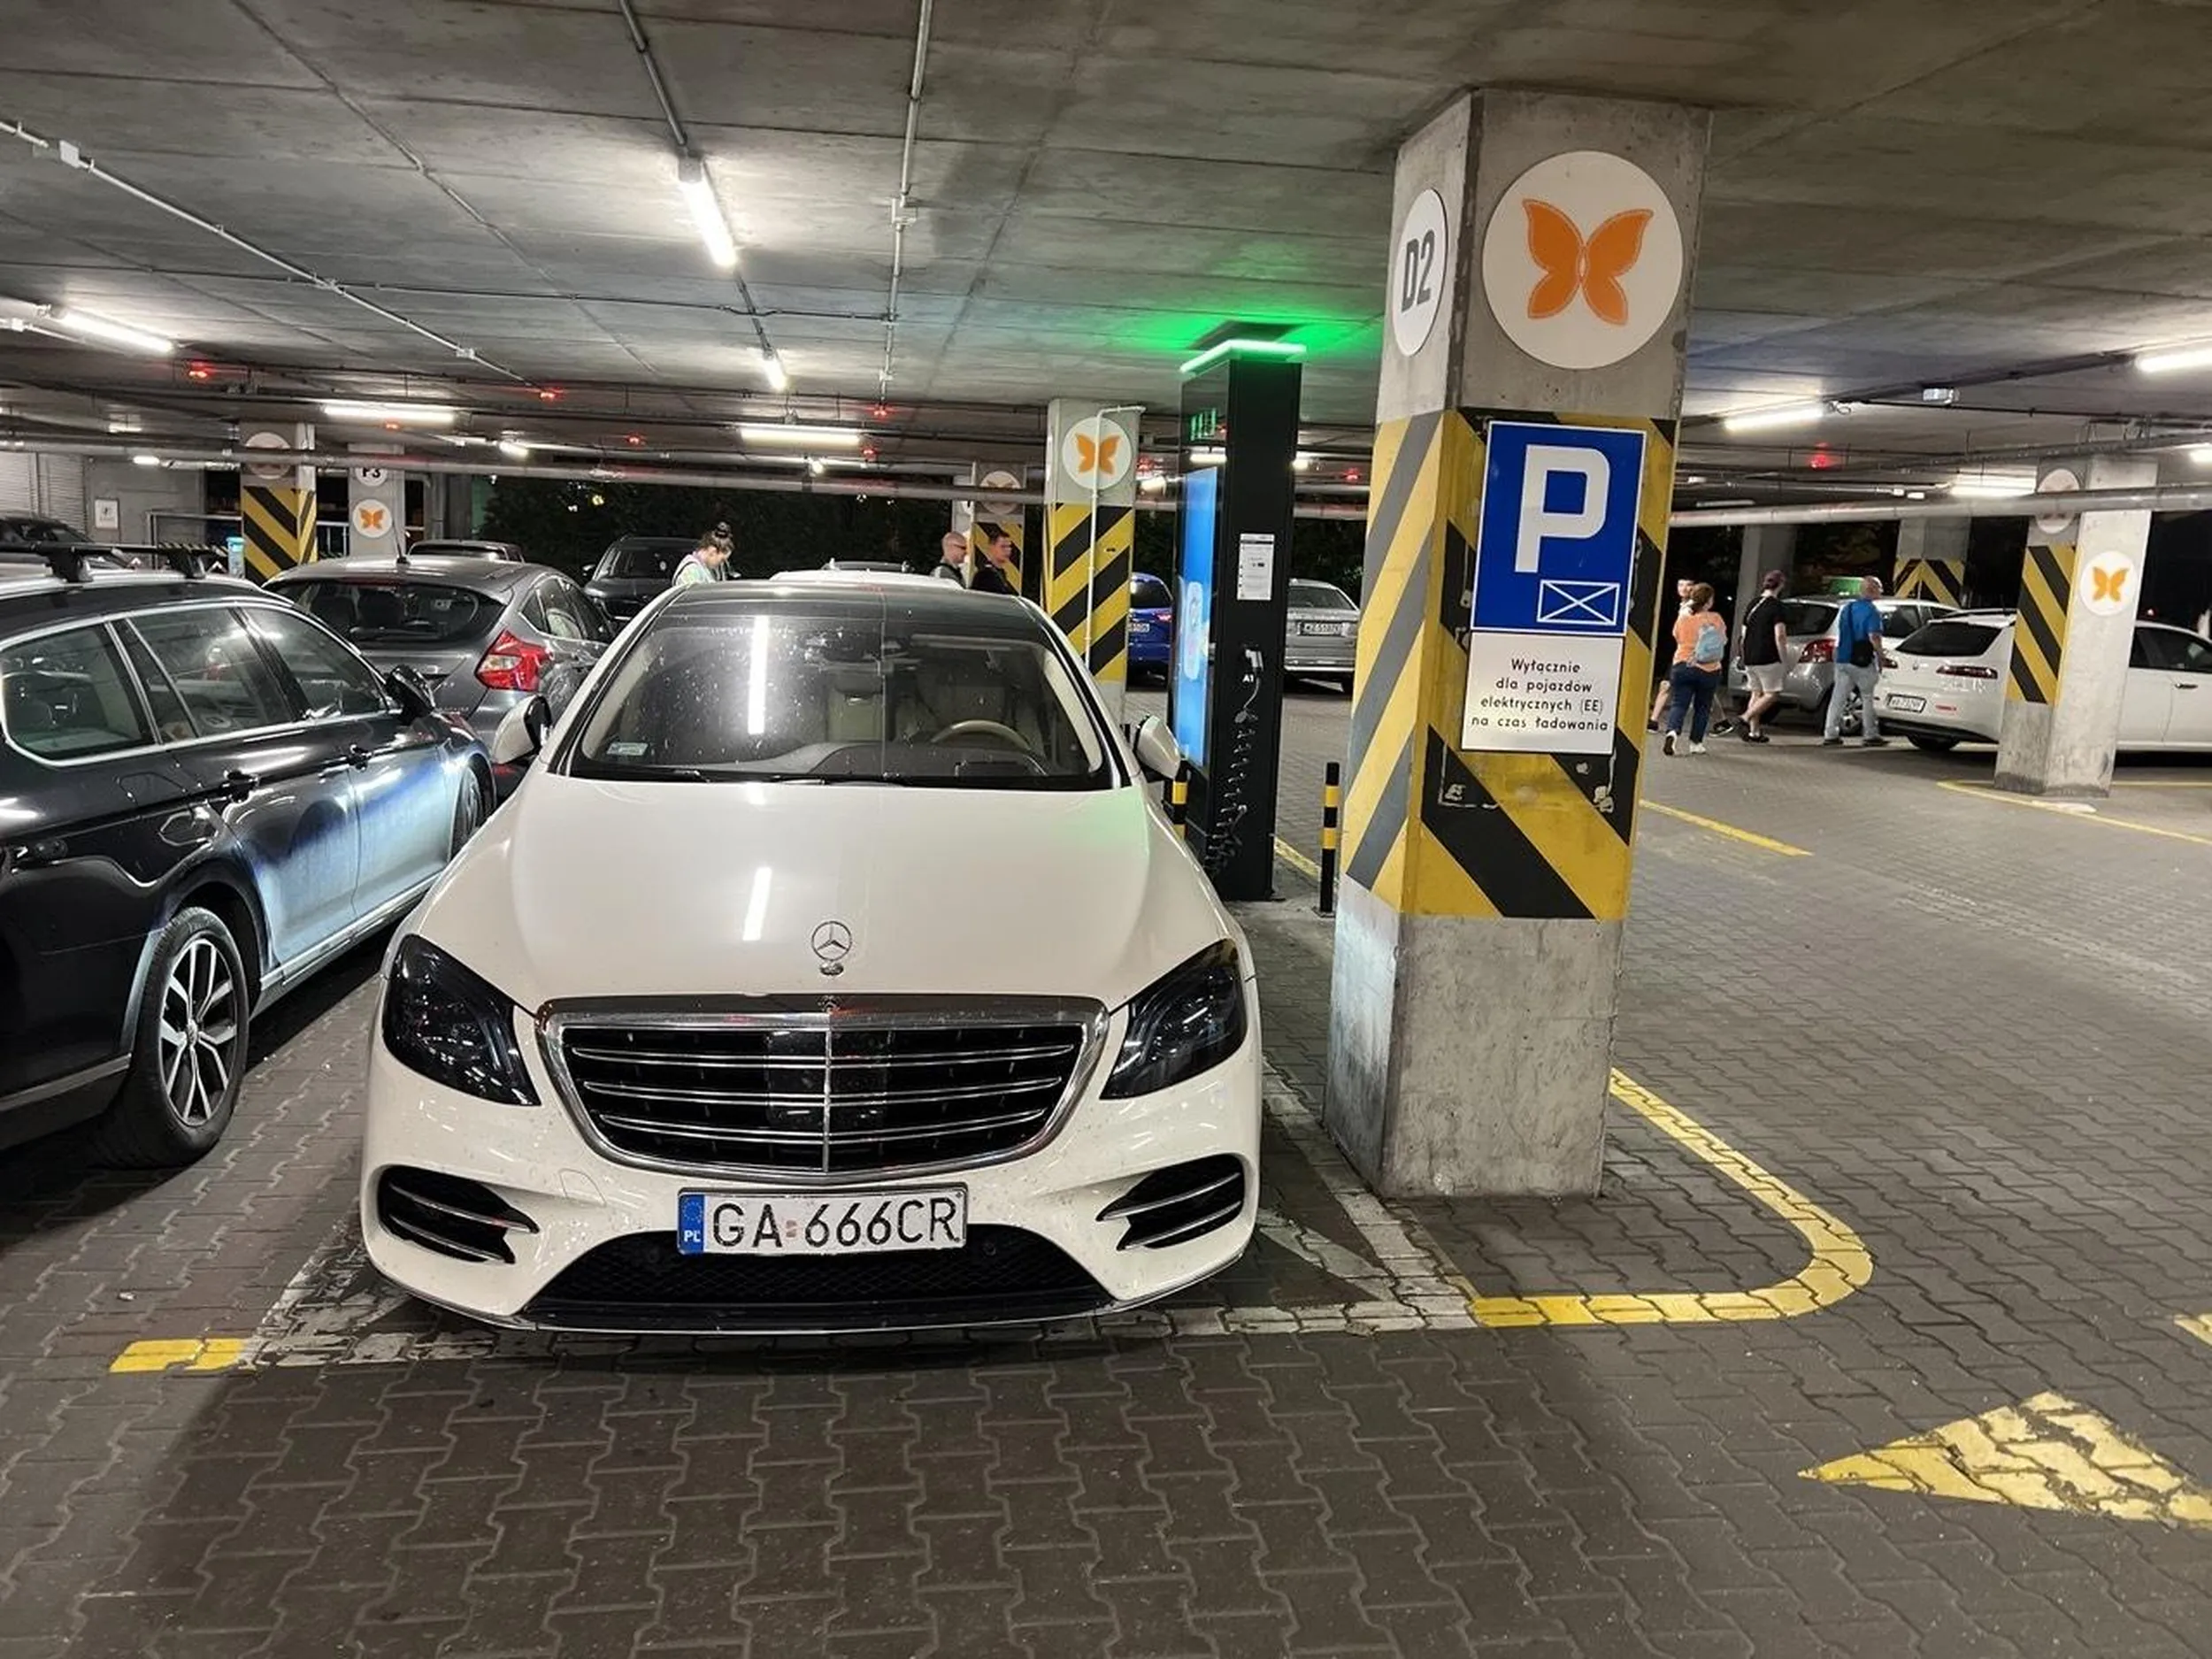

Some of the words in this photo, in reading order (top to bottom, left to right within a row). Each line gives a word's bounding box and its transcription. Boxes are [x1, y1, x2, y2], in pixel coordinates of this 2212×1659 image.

[1402, 229, 1435, 312] D2
[1515, 444, 1610, 573] P
[1511, 657, 1581, 674] Wyłącznie
[1496, 678, 1518, 689] dla
[1526, 680, 1593, 694] pojazdów
[1480, 696, 1572, 713] elektrycznych
[1580, 699, 1604, 715] (EE)
[1471, 717, 1488, 726] na
[1497, 717, 1527, 728] czas
[1535, 717, 1609, 731] ładowania
[713, 1202, 783, 1248] GA
[804, 1197, 961, 1248] 666CR
[683, 1230, 701, 1242] PL
